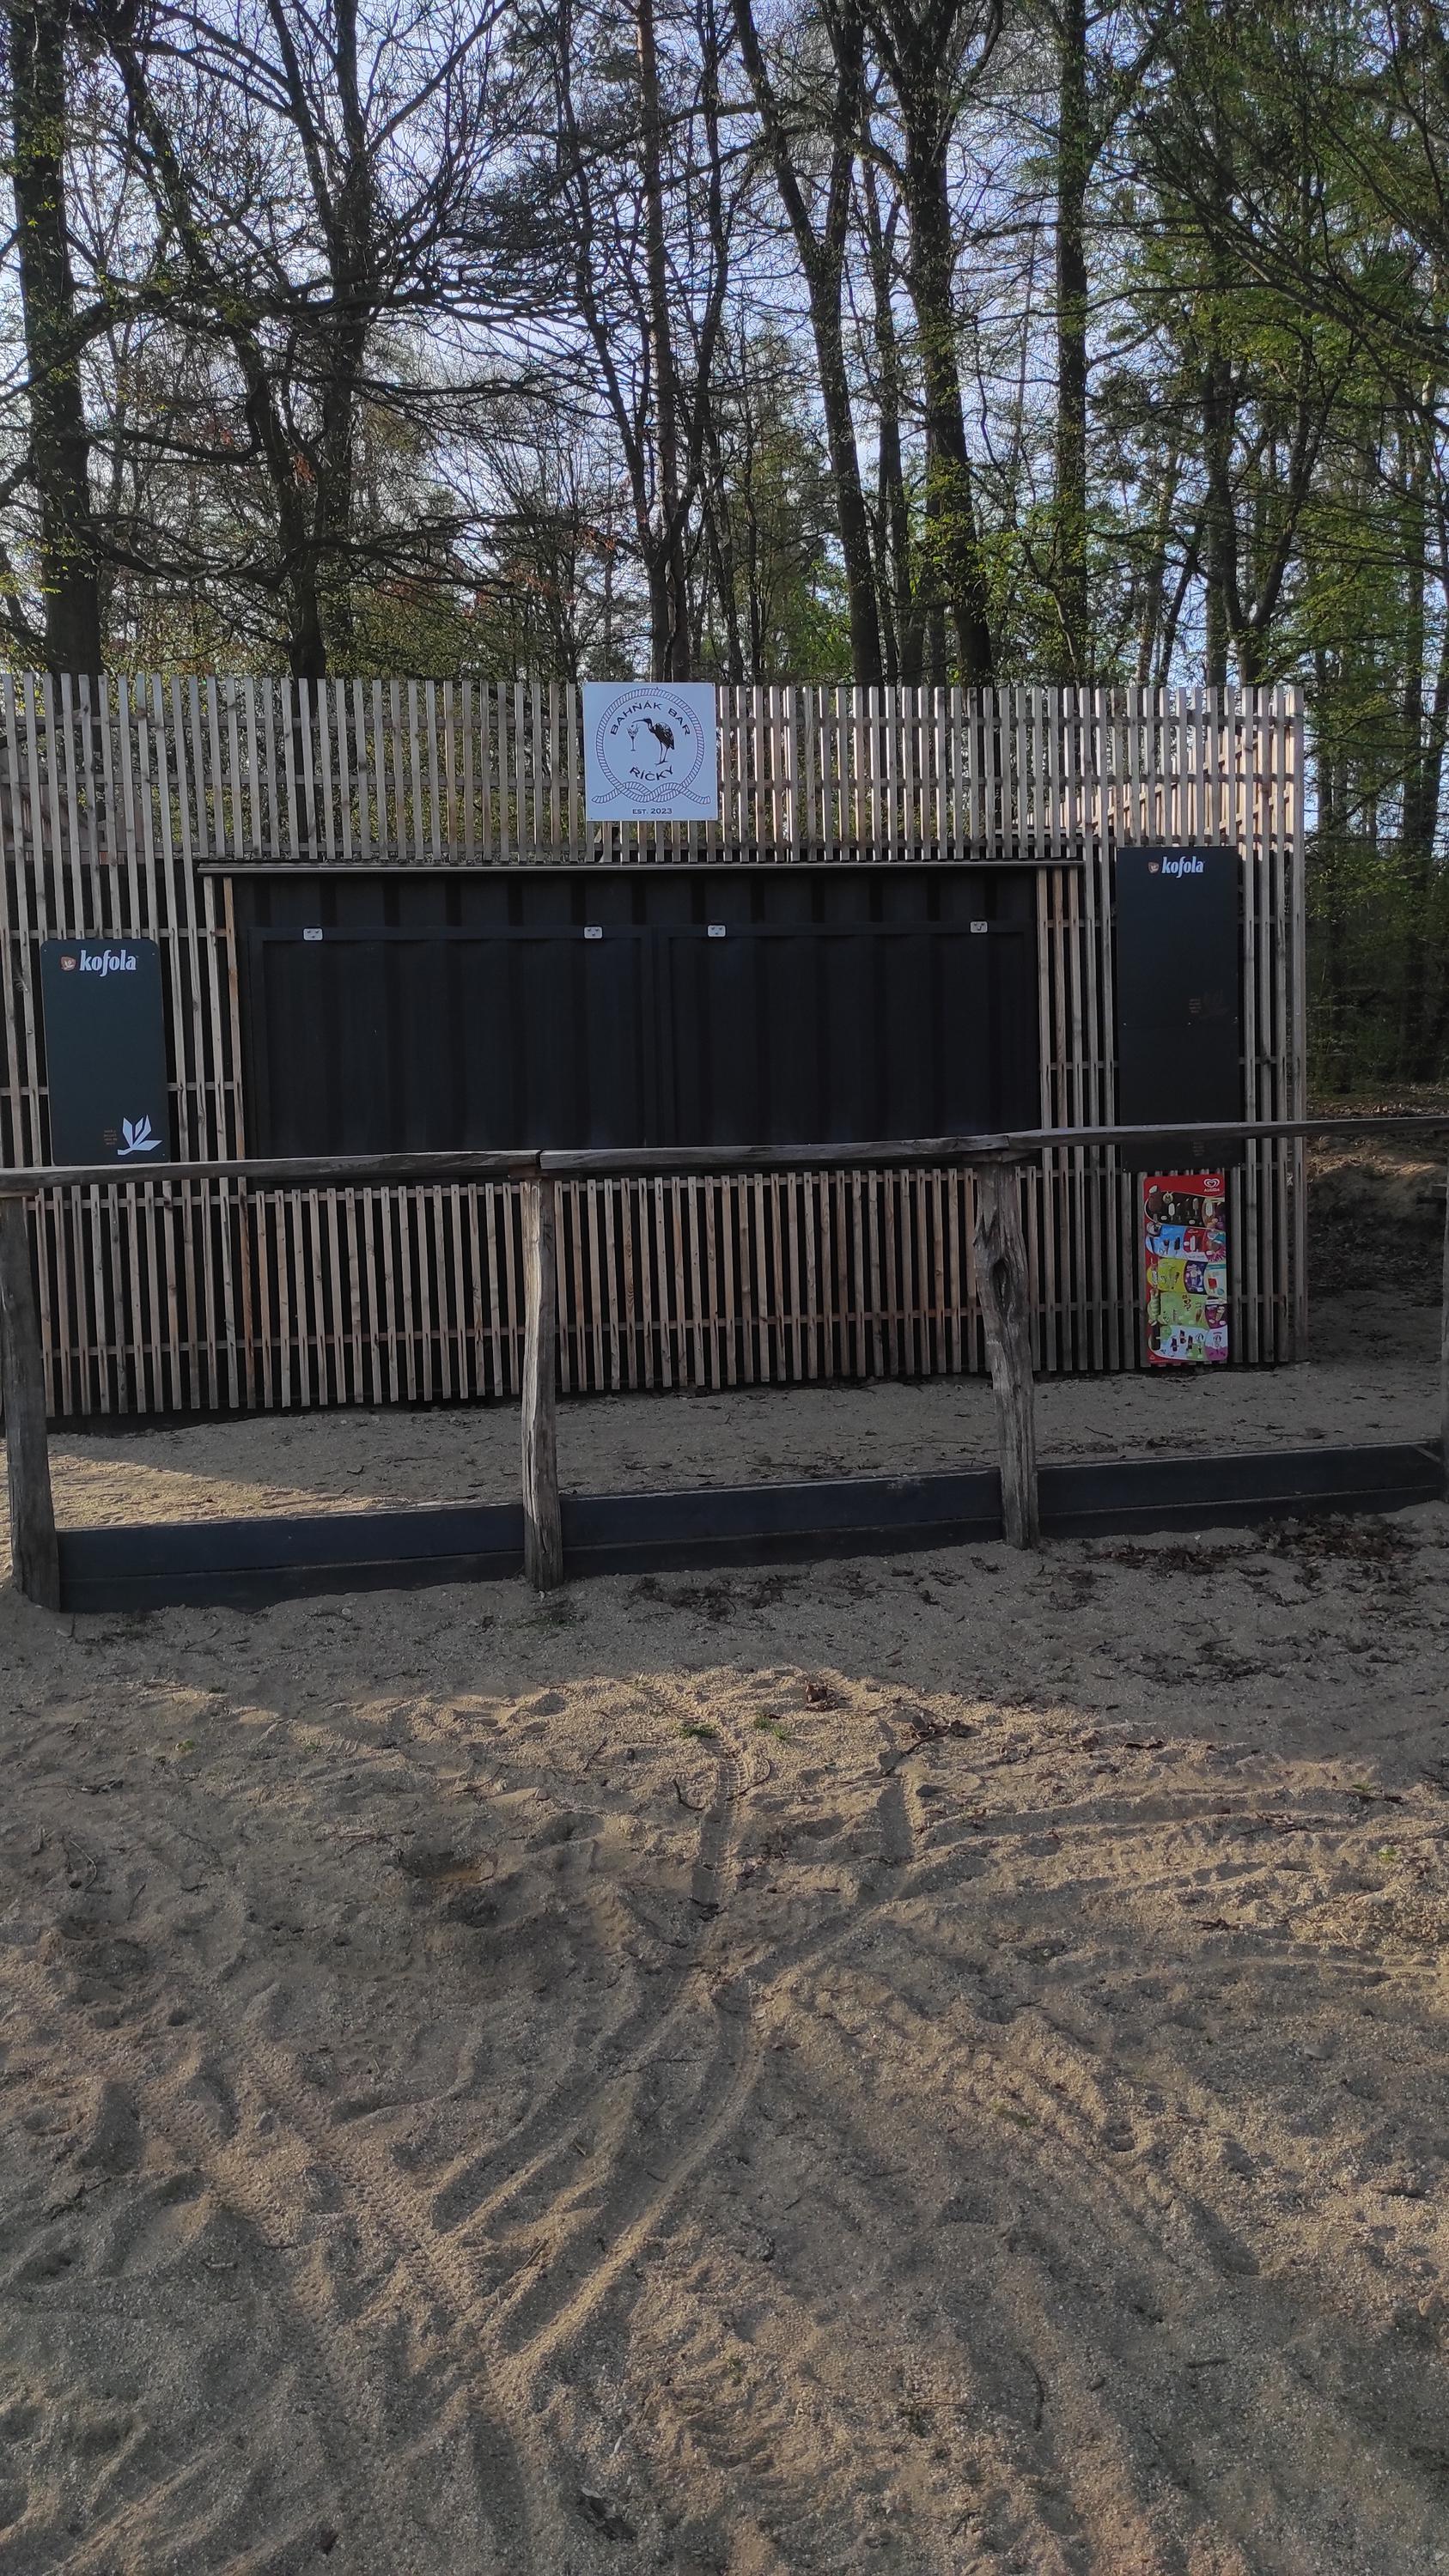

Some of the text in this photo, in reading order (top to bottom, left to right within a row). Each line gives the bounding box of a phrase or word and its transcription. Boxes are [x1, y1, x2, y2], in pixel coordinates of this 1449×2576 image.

[610, 700, 691, 736] BAHŇÁK BAR
[1161, 856, 1204, 878] kofola
[79, 950, 137, 976] kofola
